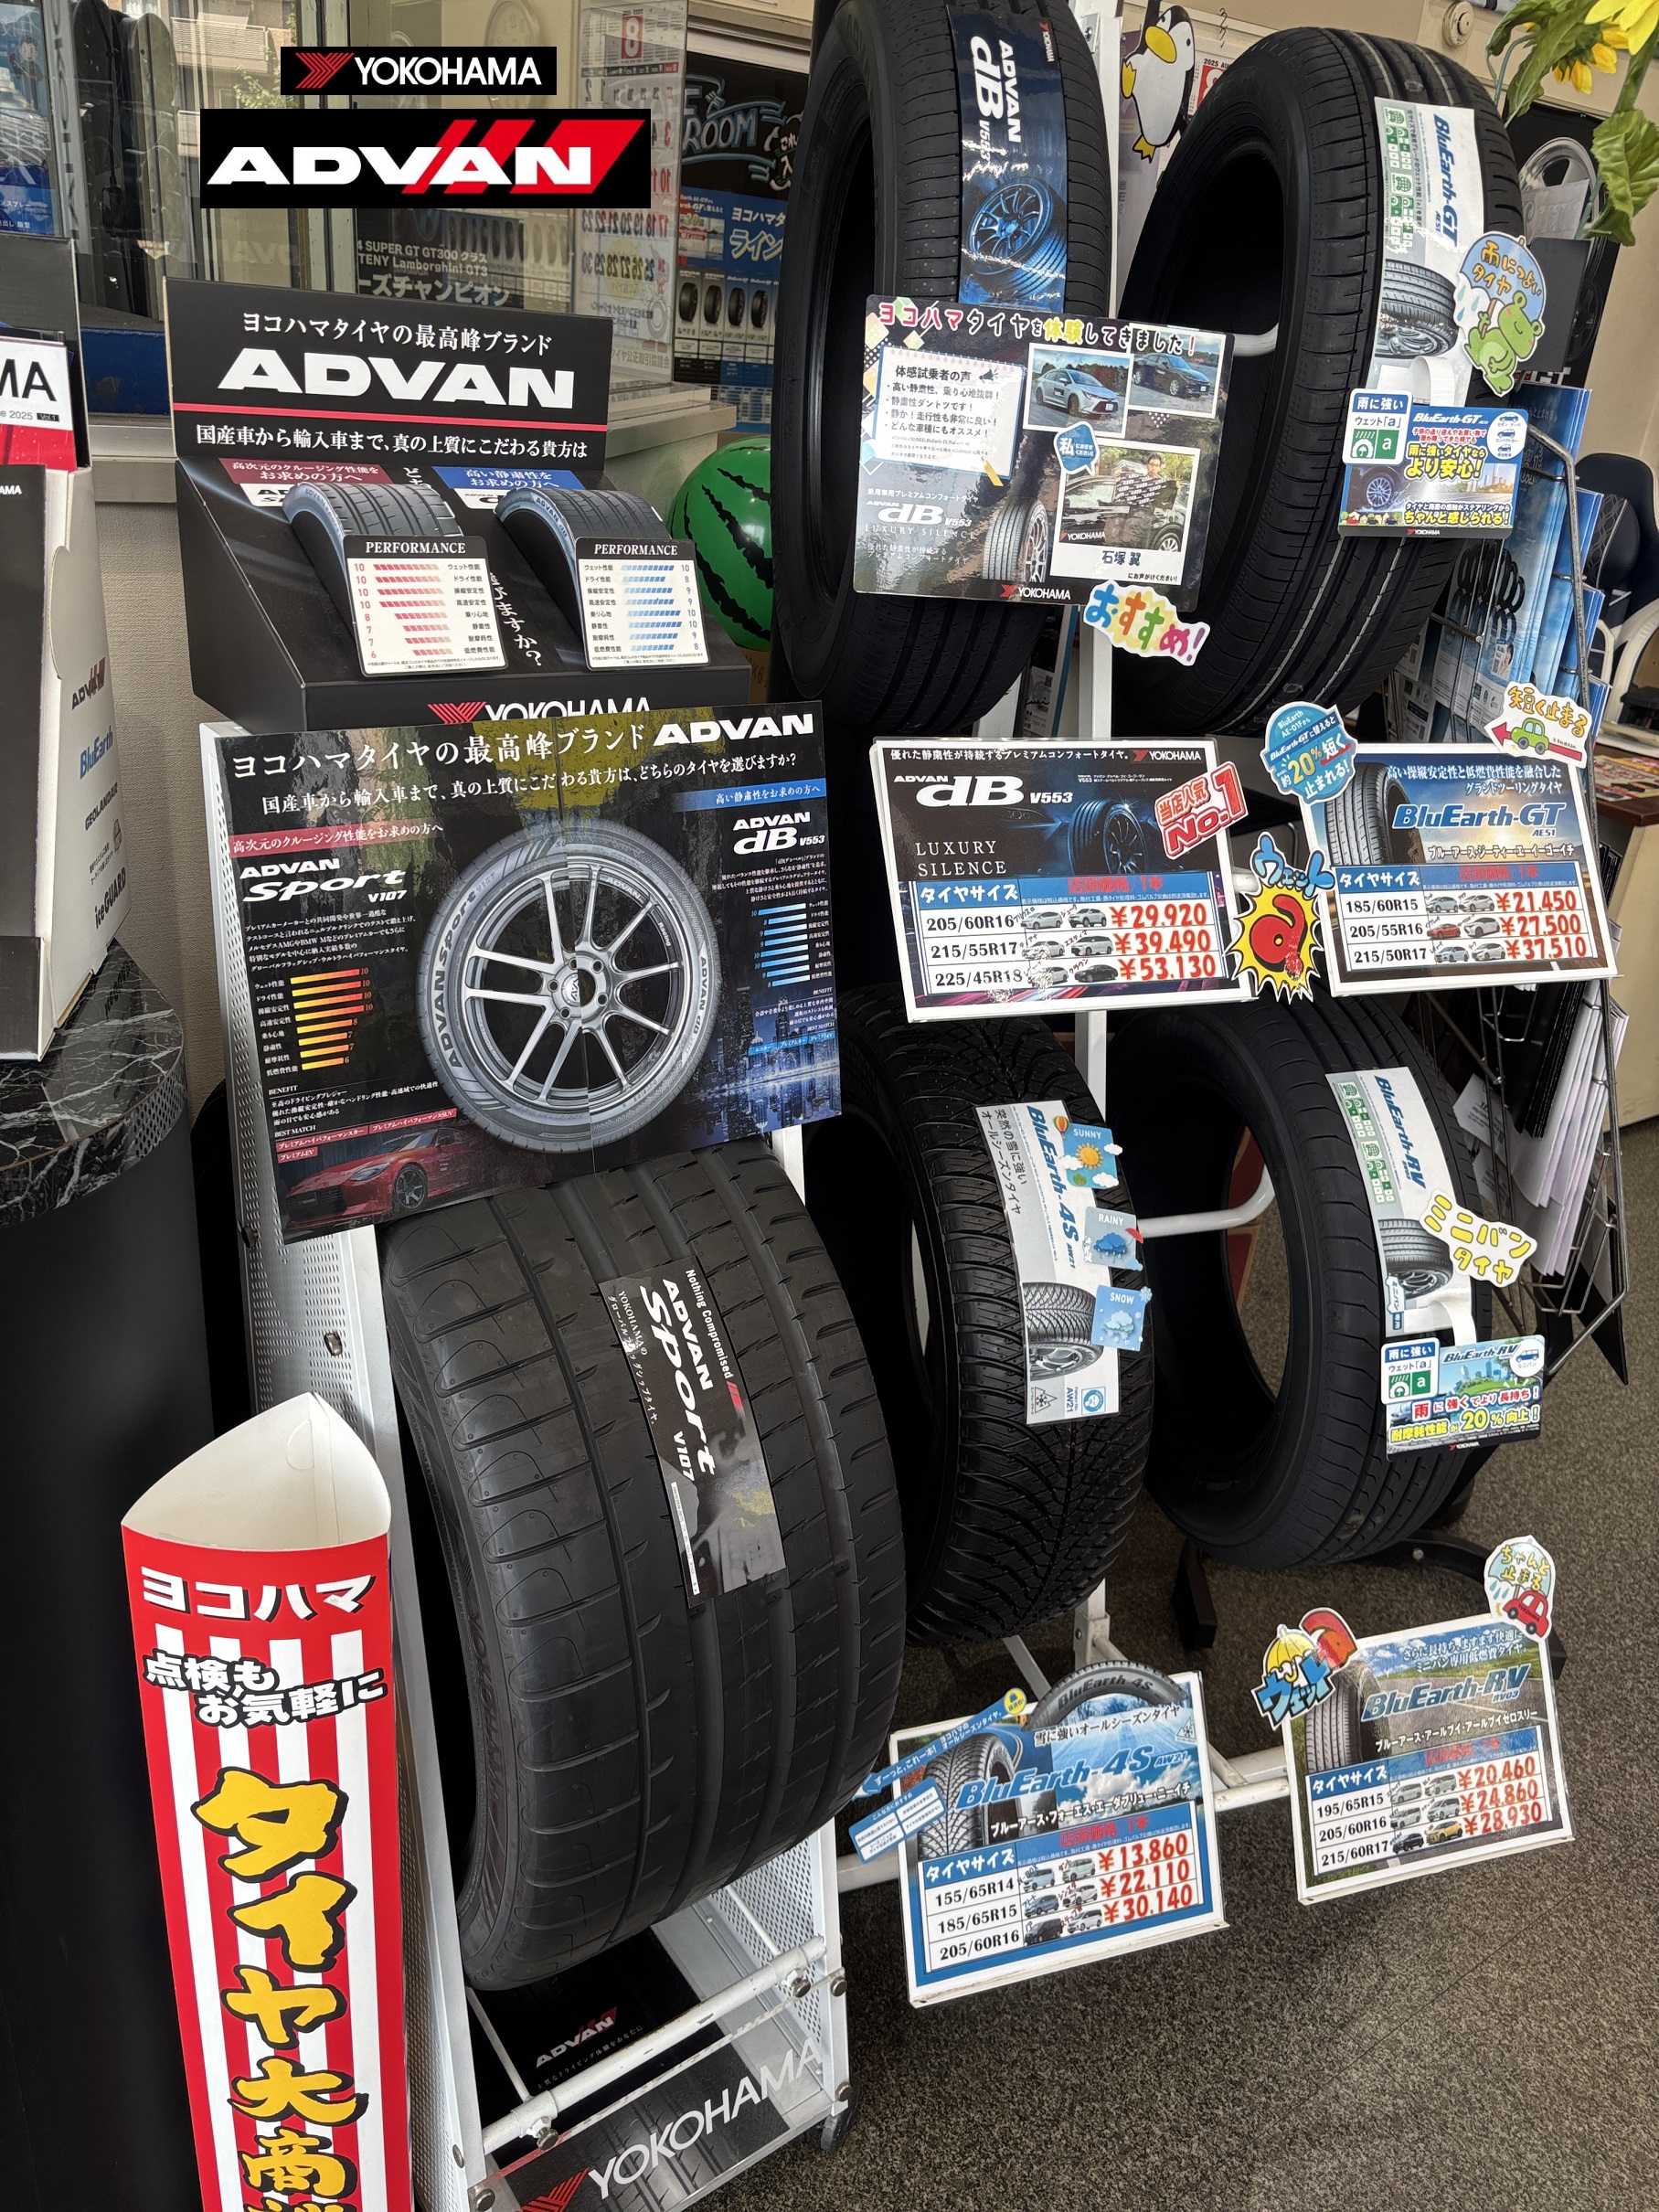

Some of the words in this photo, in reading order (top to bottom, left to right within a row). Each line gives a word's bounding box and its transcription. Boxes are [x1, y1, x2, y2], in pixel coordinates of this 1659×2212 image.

[1204, 58, 1218, 67] 2025
[970, 36, 1003, 120] dB
[999, 39, 1021, 143] ADVAN
[1433, 113, 1458, 247] BluEarth-GT
[366, 241, 402, 255] SUPER
[405, 245, 420, 257] GT
[422, 248, 457, 261] GT300
[461, 252, 488, 263] クラス
[393, 256, 463, 272] Lamborghini
[466, 265, 488, 277] GT3
[1473, 264, 1513, 295] タイヤ
[1481, 241, 1542, 296] 雨につよい
[243, 312, 552, 356] ヨコハマタイヤの最高峰ブランド
[218, 347, 575, 409] ADVAN
[896, 366, 972, 382] 体感試乗者の声
[9, 409, 33, 420] 2025
[1357, 397, 1404, 410] 雨に強い
[1355, 416, 1402, 429] ウェット「a」
[1413, 412, 1483, 425] BluEarth-GT
[196, 423, 588, 459] 国産車から輸入車まで、真の上質にこだわる貴方は
[1059, 439, 1074, 455] 私
[1382, 438, 1391, 451] a
[1409, 444, 1485, 458] 雨に強いタイヤなら
[260, 471, 363, 483] お求めの方へ
[1406, 459, 1483, 479] より安心!
[877, 503, 944, 525] dB
[865, 525, 913, 535] LUXURY
[366, 542, 465, 554] PERFORMANCE
[594, 544, 678, 556] PERFORMANCE
[1017, 587, 1071, 600] YOKOHAMA
[1084, 582, 1206, 662] おすすめ!
[1277, 710, 1304, 729] BluEarth
[1507, 686, 1588, 739] 短く止まる
[80, 726, 113, 780] BluEarth
[233, 724, 645, 779] ヨコハマタイヤの最高峰ブランド
[654, 714, 814, 747] ADVAN
[1148, 750, 1202, 761] YOKOHAMA
[1322, 733, 1346, 760] 短く
[893, 775, 949, 783] ADVAN
[1304, 760, 1350, 800] 止まれる!
[1387, 764, 1561, 781] 高い操縦安定性と低燃費性能を融合した
[715, 786, 821, 805] 高い静粛性をお求めの方へ
[915, 775, 1025, 807] dB
[1029, 791, 1074, 804] V553
[1156, 778, 1210, 824] 当店人気
[1464, 782, 1563, 796] グランドツーリングタイヤ
[85, 782, 118, 831] GEOLANDAR
[1392, 803, 1569, 830] BluEarth-GT
[732, 812, 811, 831] ADVAN
[1531, 828, 1557, 837] AE51
[232, 823, 443, 854] 高次元のクルージング性能をお求めの方へ
[733, 827, 798, 856] dB
[799, 835, 825, 846] V553
[915, 839, 998, 856] LUXURY
[239, 858, 340, 880] ADVAN
[918, 860, 1006, 877] SILENCE
[1253, 834, 1335, 898] ウェット
[1339, 872, 1421, 888] タイヤサイズ
[95, 867, 126, 929] iceGUARD
[243, 870, 407, 902] Sport
[367, 890, 408, 903] V107
[920, 883, 1019, 904] タイヤサイズ
[1345, 899, 1419, 914] 185/60R15
[1494, 889, 1578, 913] ¥21,450
[926, 914, 1015, 932] 205/60R16
[1109, 902, 1207, 930] ¥29,920
[1500, 914, 1582, 938] ¥27,500
[657, 921, 672, 947] Racing
[1112, 928, 1211, 956] ¥39,490
[1349, 922, 1423, 939] 205/55R16
[931, 941, 1018, 960] 215/55R17
[1354, 948, 1428, 964] 215/50R17
[1505, 936, 1588, 961] ¥37,510
[935, 969, 1023, 988] 225/45R18
[1118, 954, 1217, 982] ¥53,130
[433, 971, 463, 1069] ADVAN
[268, 1085, 299, 1095] BENEFIT
[274, 1127, 292, 1137] BEST
[292, 1124, 316, 1135] MATCH
[1073, 1128, 1101, 1140] SUNNY
[1374, 1075, 1426, 1189] BluEarth-RV
[994, 1109, 1028, 1186] 突然の雪に強い
[982, 1110, 1022, 1216] オールシーズンタイヤ
[1026, 1105, 1079, 1244] BluEarth-4S
[1098, 1213, 1124, 1227] RAINY
[1423, 1193, 1533, 1259] ミニバン
[1453, 1249, 1515, 1284] タイヤ
[1110, 1292, 1134, 1305] SNOW
[663, 1279, 714, 1390] ADVAN
[686, 1269, 705, 1308] Nothing
[702, 1309, 734, 1379] Compromised
[1388, 1345, 1432, 1361] 雨に強い
[1388, 1360, 1432, 1374] ウェット「a」
[640, 1285, 715, 1475] Sport
[1417, 1377, 1426, 1388] a
[674, 1431, 695, 1482] V107
[1500, 1545, 1551, 1577] ちゃんと
[1501, 1568, 1542, 1591] 止まる
[142, 1566, 376, 1622] ヨコハマ
[145, 1653, 276, 1693] 点検も
[198, 1669, 385, 1726] お気軽に
[1361, 1663, 1532, 1722] BluEarth-RV
[1034, 1706, 1181, 1746] 雪に強いオールシーズンタイヤ
[954, 1745, 1154, 1811] BluEarth-4S
[1154, 1750, 1188, 1767] AW21
[1312, 1764, 1388, 1795] タイヤサイズ
[1457, 1755, 1537, 1790] ¥20,460
[1316, 1792, 1384, 1819] 195/65R15
[1459, 1779, 1539, 1813] ¥24,860
[1319, 1815, 1387, 1843] 205/60R16
[1463, 1802, 1542, 1836] ¥28,930
[925, 1846, 1016, 1882] タイヤサイズ
[1098, 1833, 1188, 1871] ¥13,860
[1321, 1840, 1388, 1867] 215/60R17
[1100, 1858, 1191, 1898] ¥22,110
[934, 1877, 1015, 1908] 155/65R14
[1102, 1884, 1193, 1923] ¥30,140
[938, 1904, 1018, 1935] 185/65R15
[940, 1931, 1020, 1962] 205/60R16
[536, 2015, 616, 2068] ADVAN
[589, 2037, 823, 2200] YOKOHAMA
